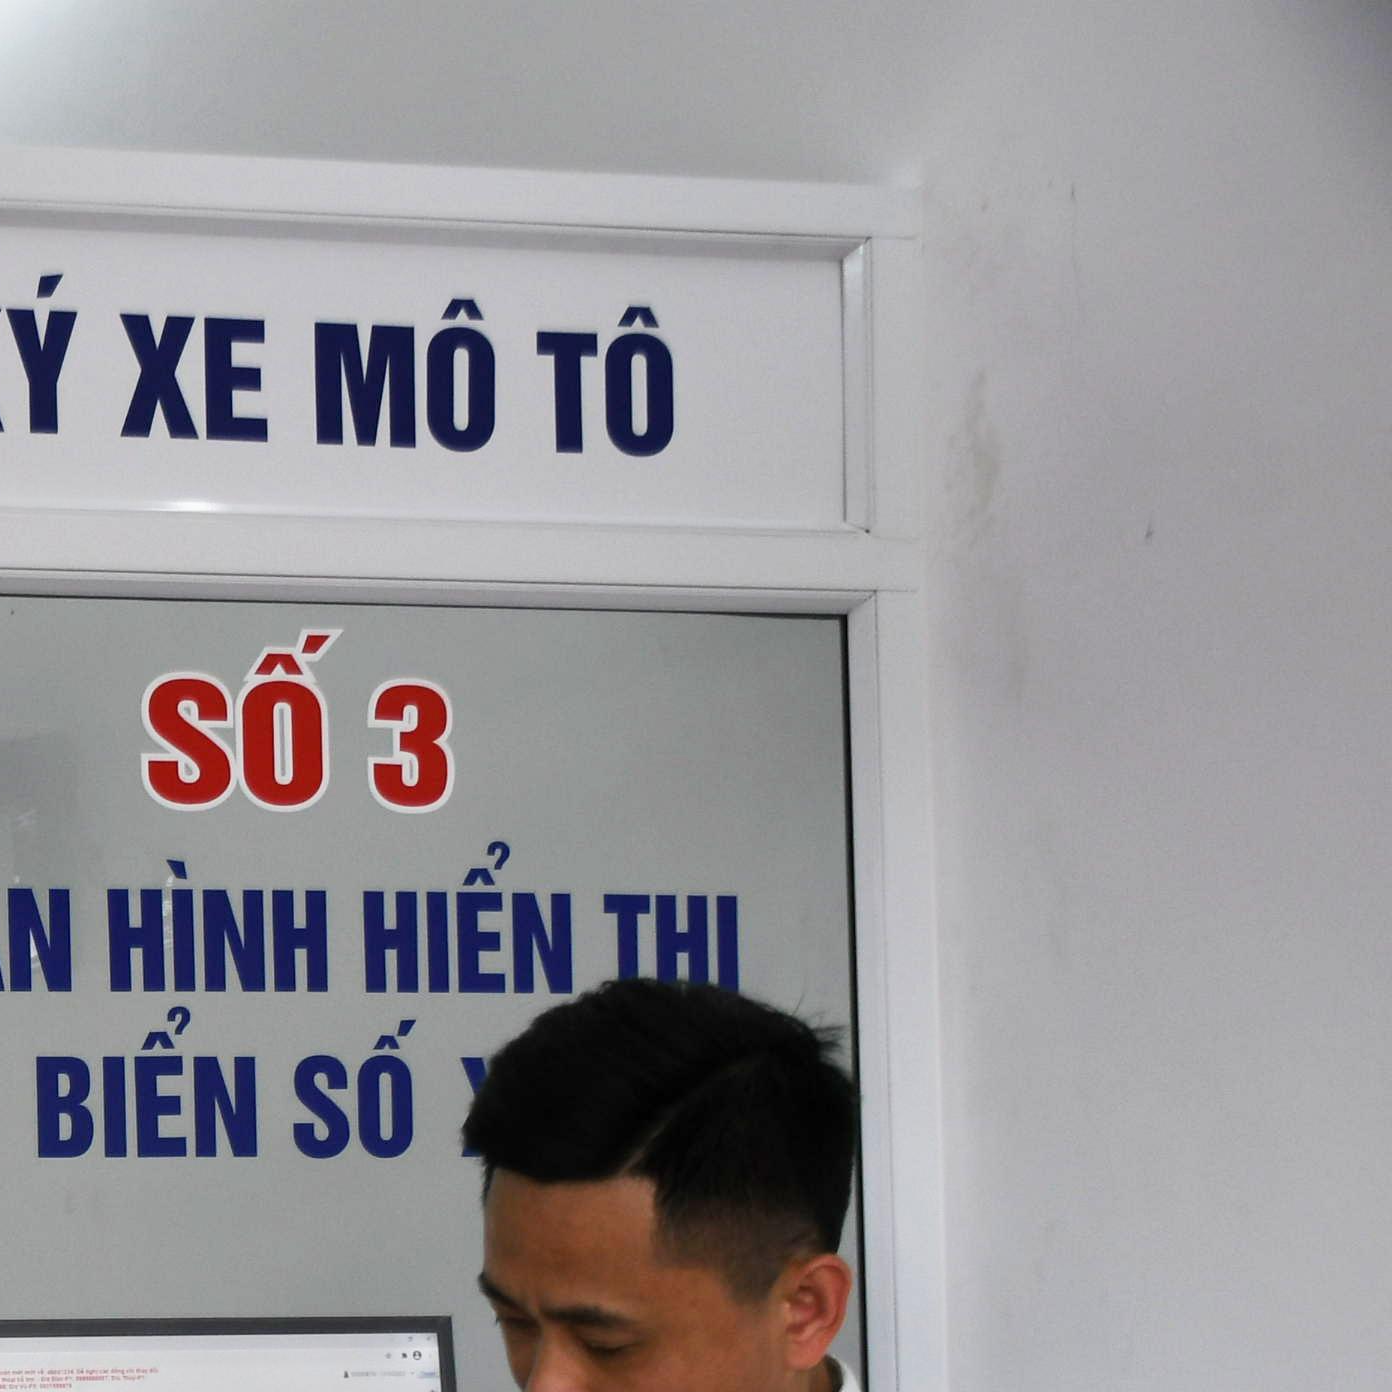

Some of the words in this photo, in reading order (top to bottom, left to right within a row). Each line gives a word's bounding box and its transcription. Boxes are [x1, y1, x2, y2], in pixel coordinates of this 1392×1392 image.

[120, 313, 268, 443] XE
[313, 298, 496, 453] MÔ
[536, 306, 674, 457] TÔ
[142, 629, 340, 811] SỐ
[368, 679, 454, 812] 3
[107, 859, 327, 994] HÌNH
[363, 841, 573, 994] HIỂN
[35, 1006, 258, 1159] BIỂN
[292, 1019, 416, 1159] SỐ
